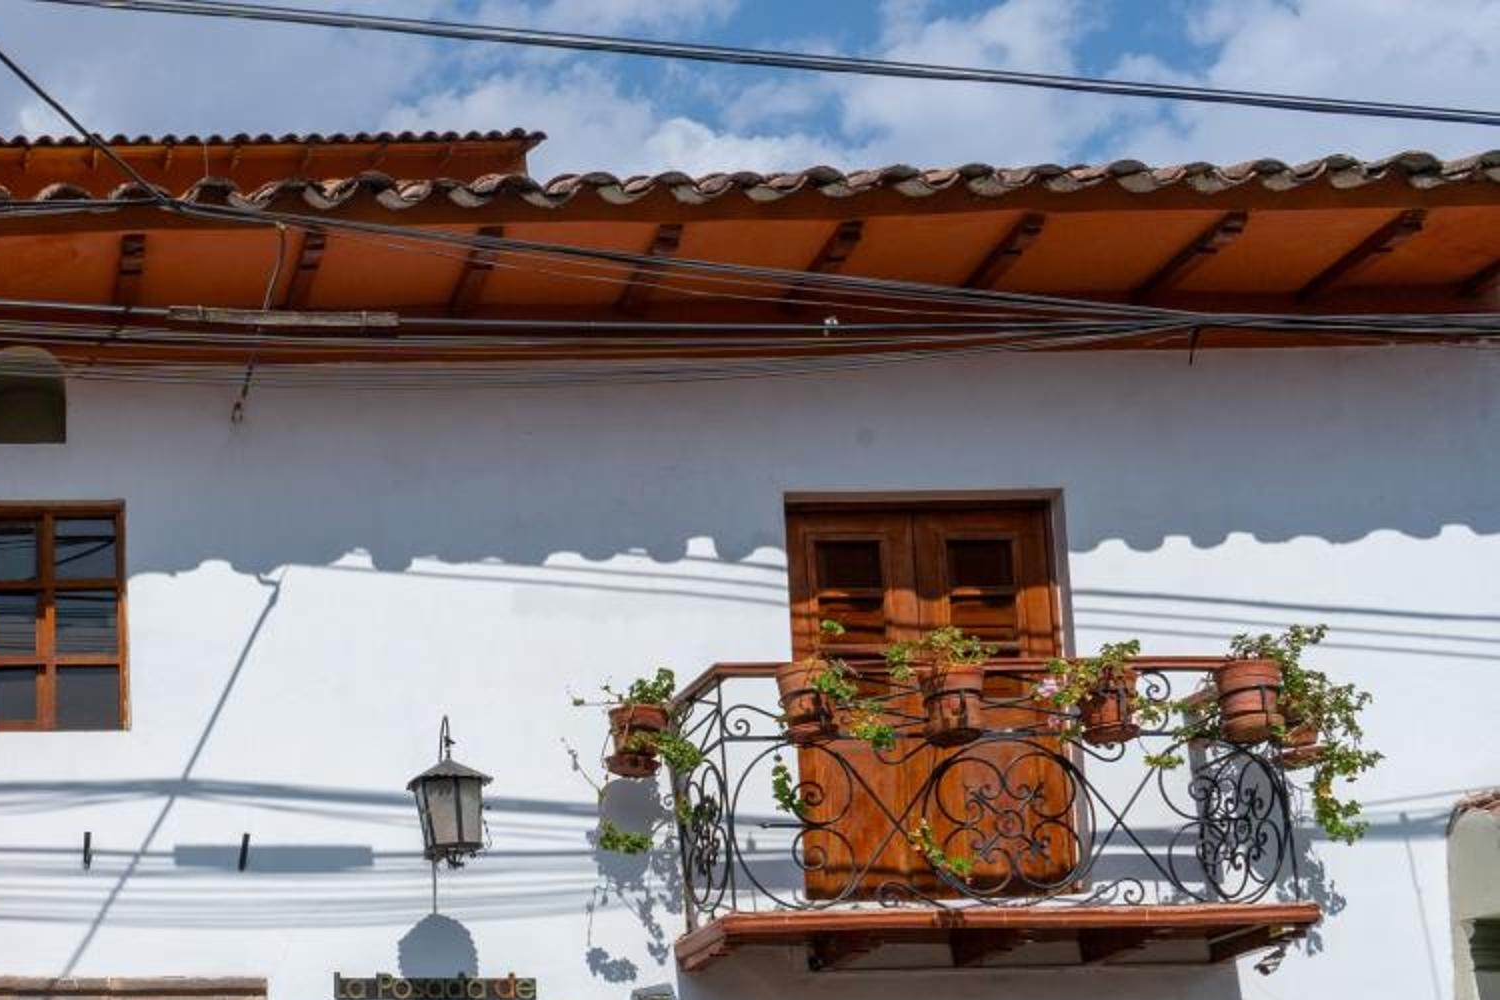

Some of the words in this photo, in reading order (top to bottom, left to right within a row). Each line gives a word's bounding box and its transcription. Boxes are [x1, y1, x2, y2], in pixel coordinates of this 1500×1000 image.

[334, 972, 367, 1000] La
[376, 973, 488, 1000] Posada
[494, 972, 536, 1000] de
